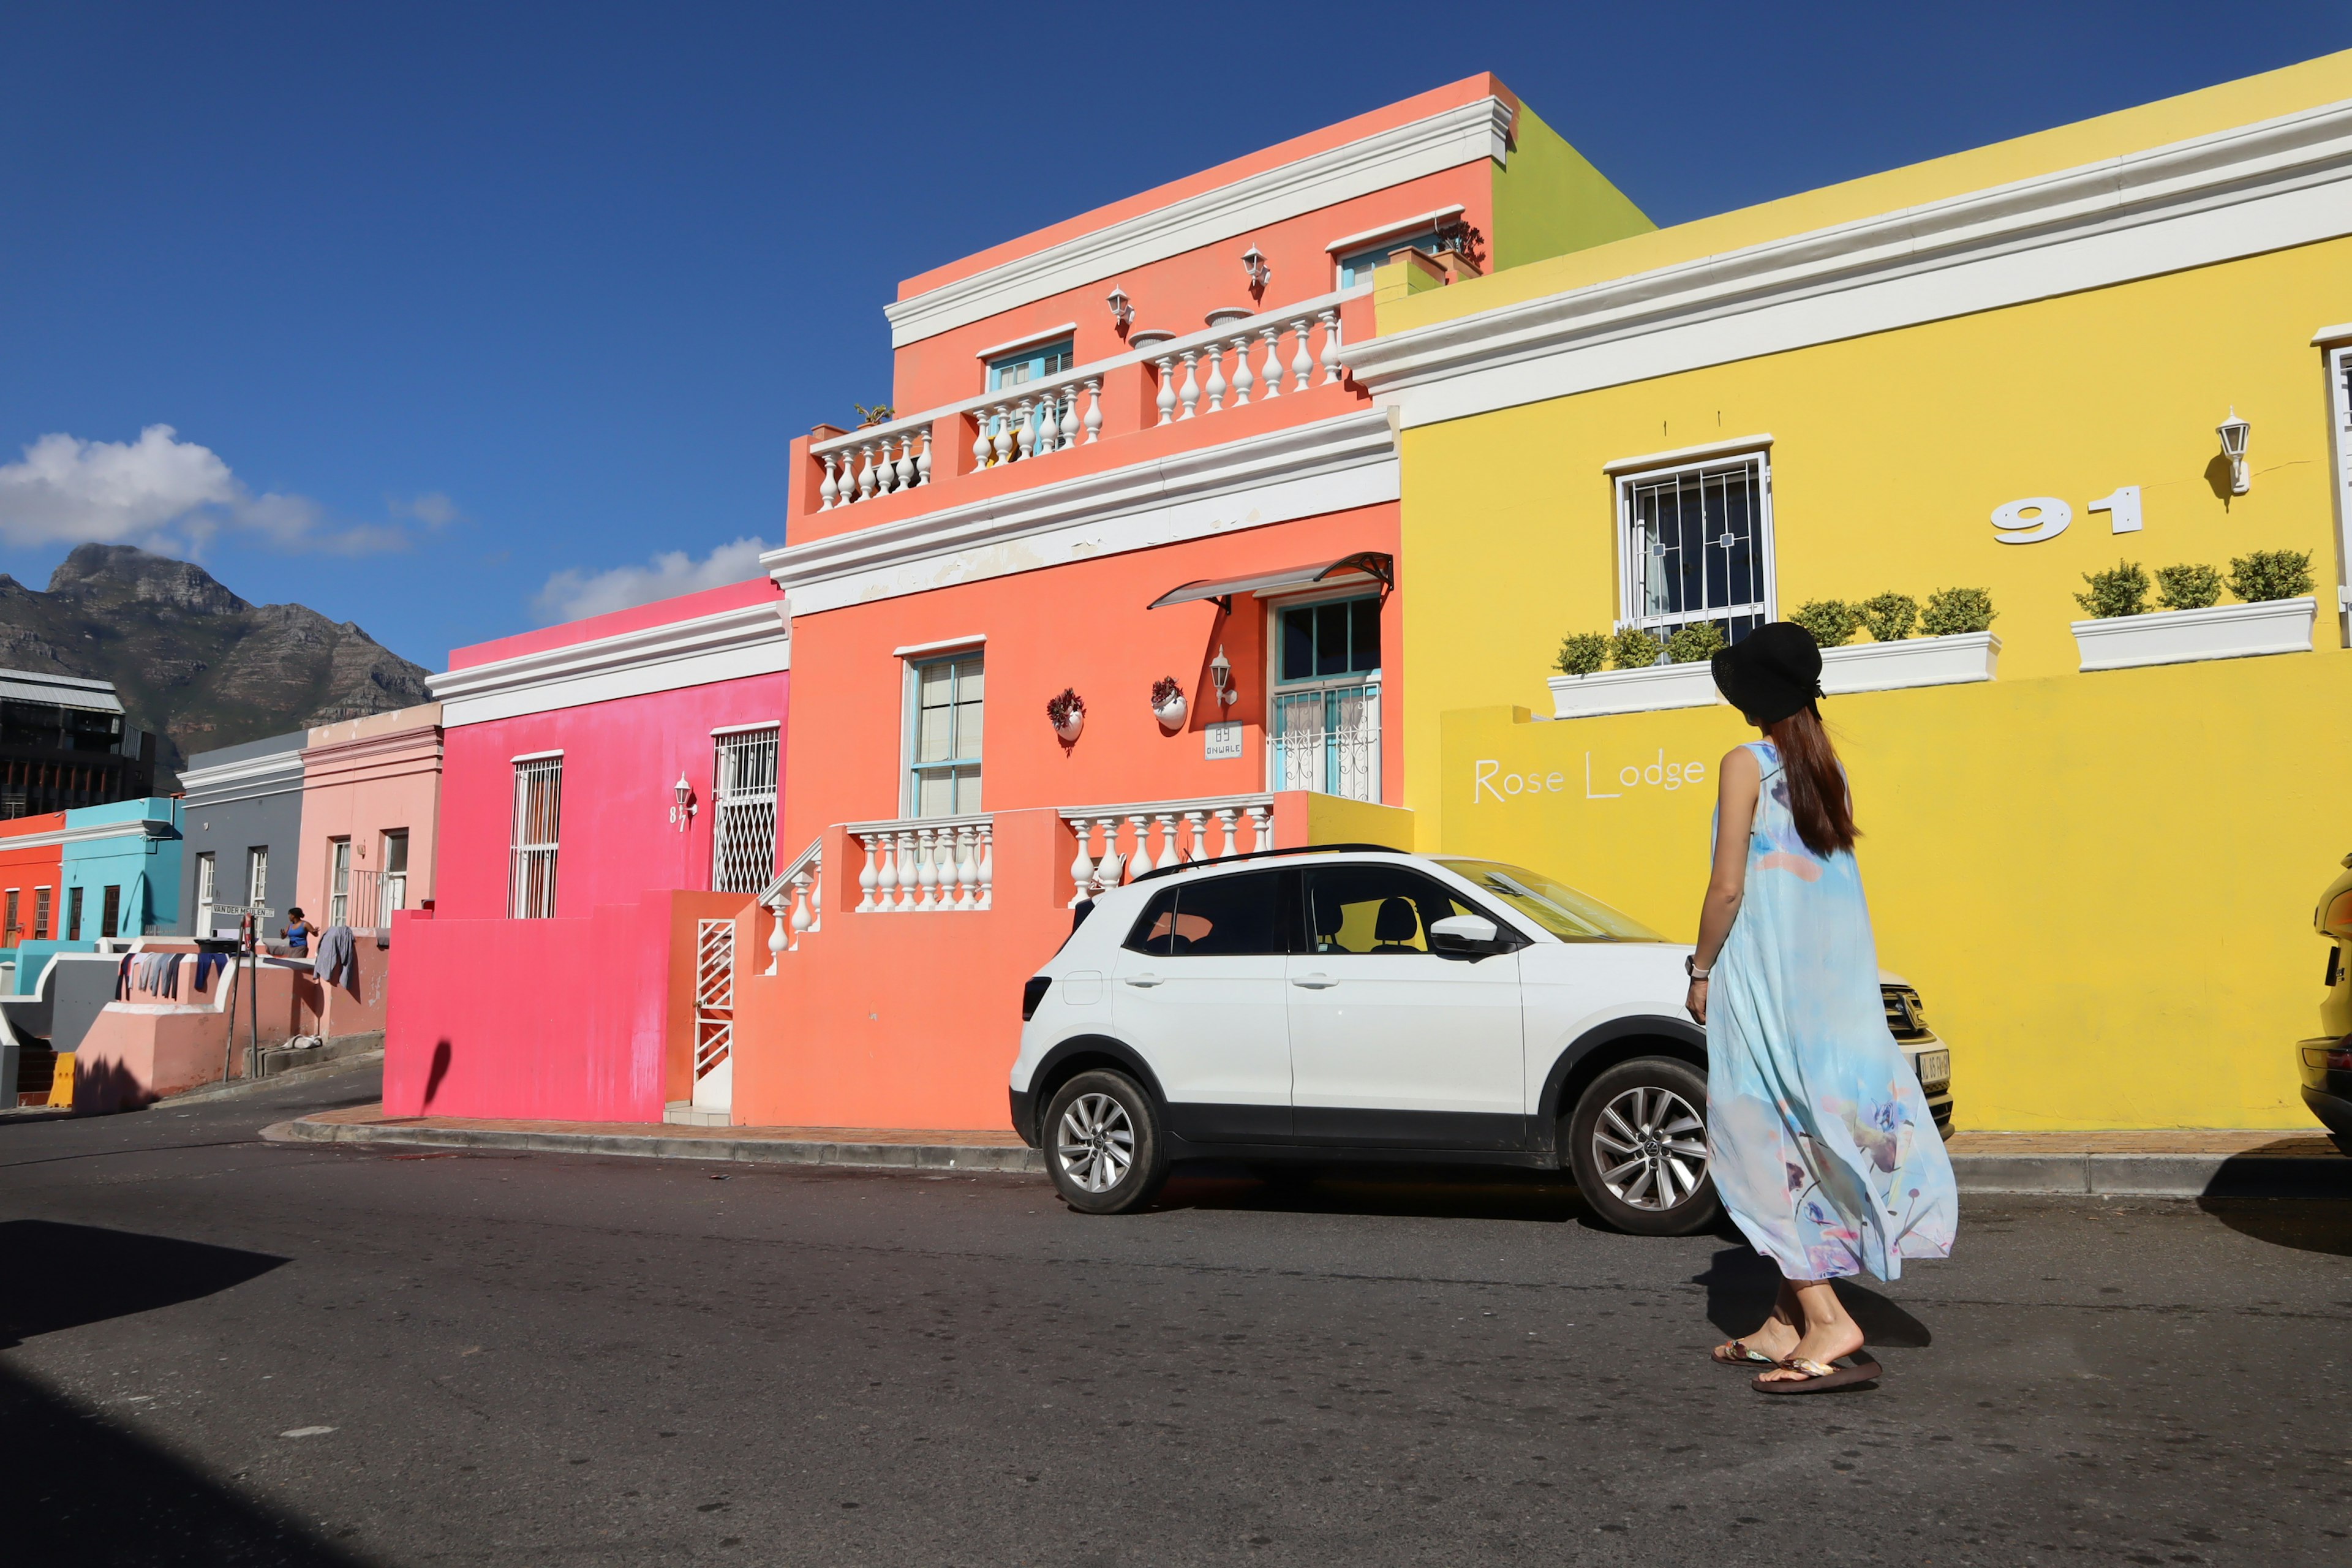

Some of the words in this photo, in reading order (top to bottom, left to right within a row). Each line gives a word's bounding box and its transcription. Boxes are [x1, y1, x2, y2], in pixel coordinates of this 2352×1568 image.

[1991, 485, 2143, 544] 91
[1216, 728, 1229, 742] 89
[1473, 760, 1564, 804] Rose
[1585, 747, 1705, 799] Lodge
[214, 905, 226, 913] VAN
[241, 908, 266, 916] MEULEN
